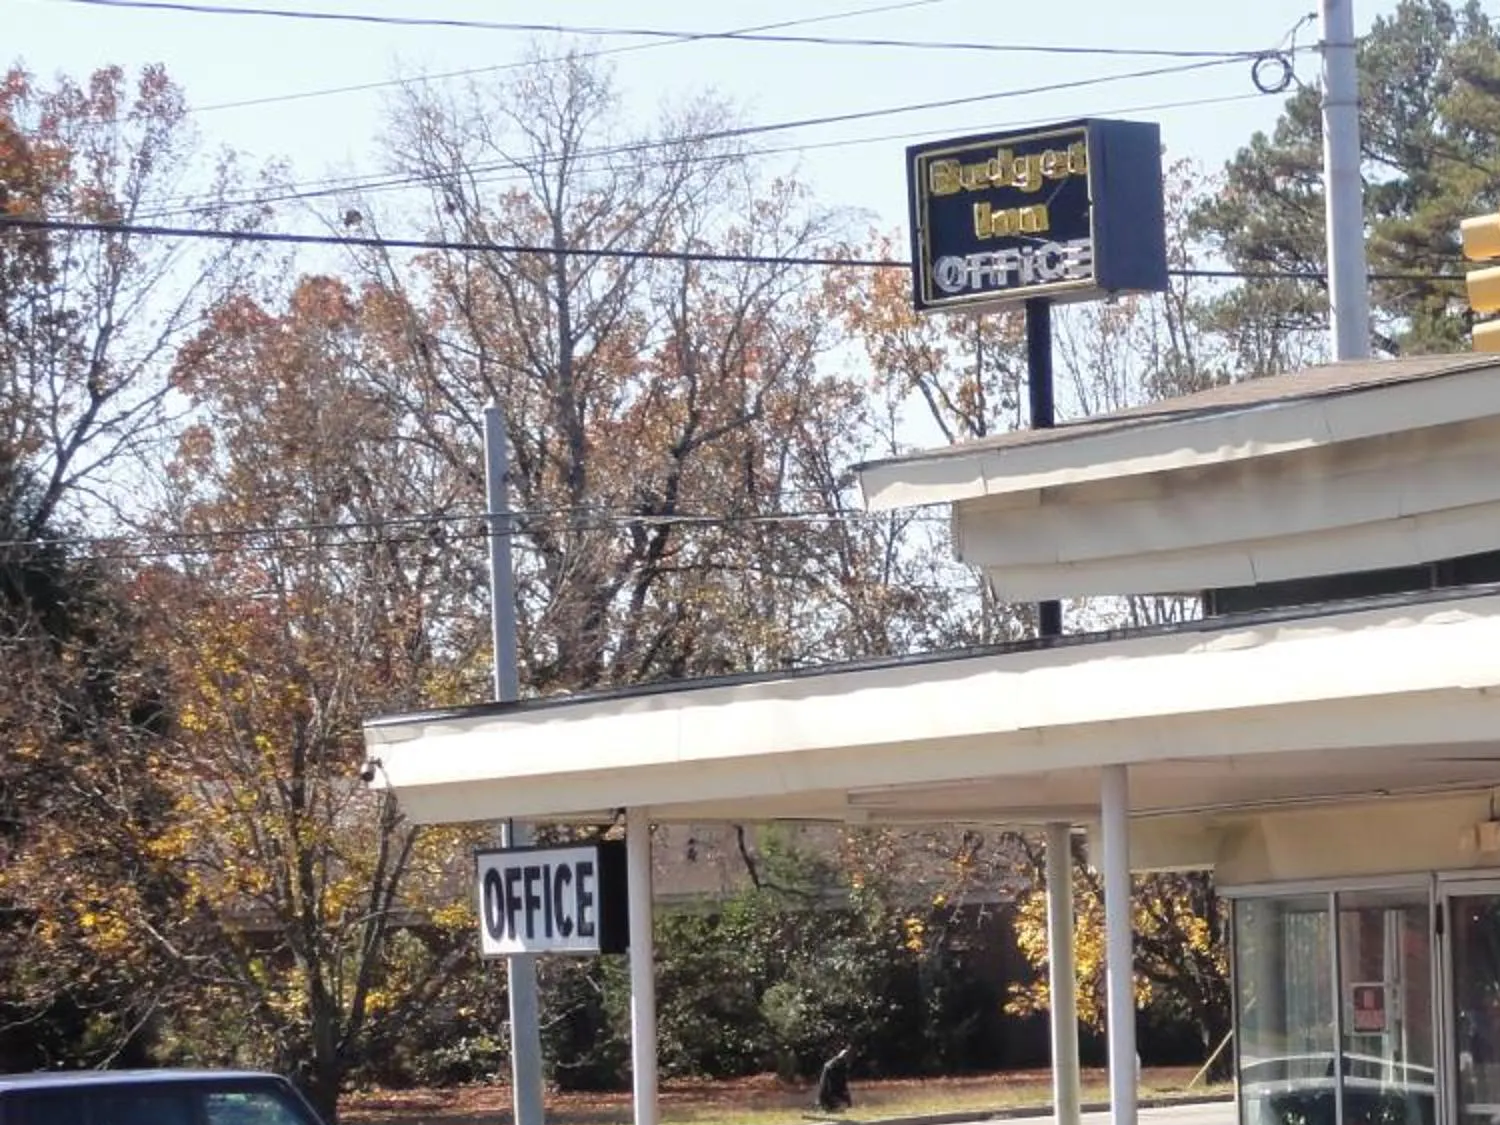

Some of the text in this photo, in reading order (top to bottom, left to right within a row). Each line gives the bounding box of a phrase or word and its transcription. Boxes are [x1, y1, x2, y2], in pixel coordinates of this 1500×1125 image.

[930, 142, 1087, 195] Budget
[974, 202, 1049, 240] Inn
[483, 861, 595, 943] OFFICE
